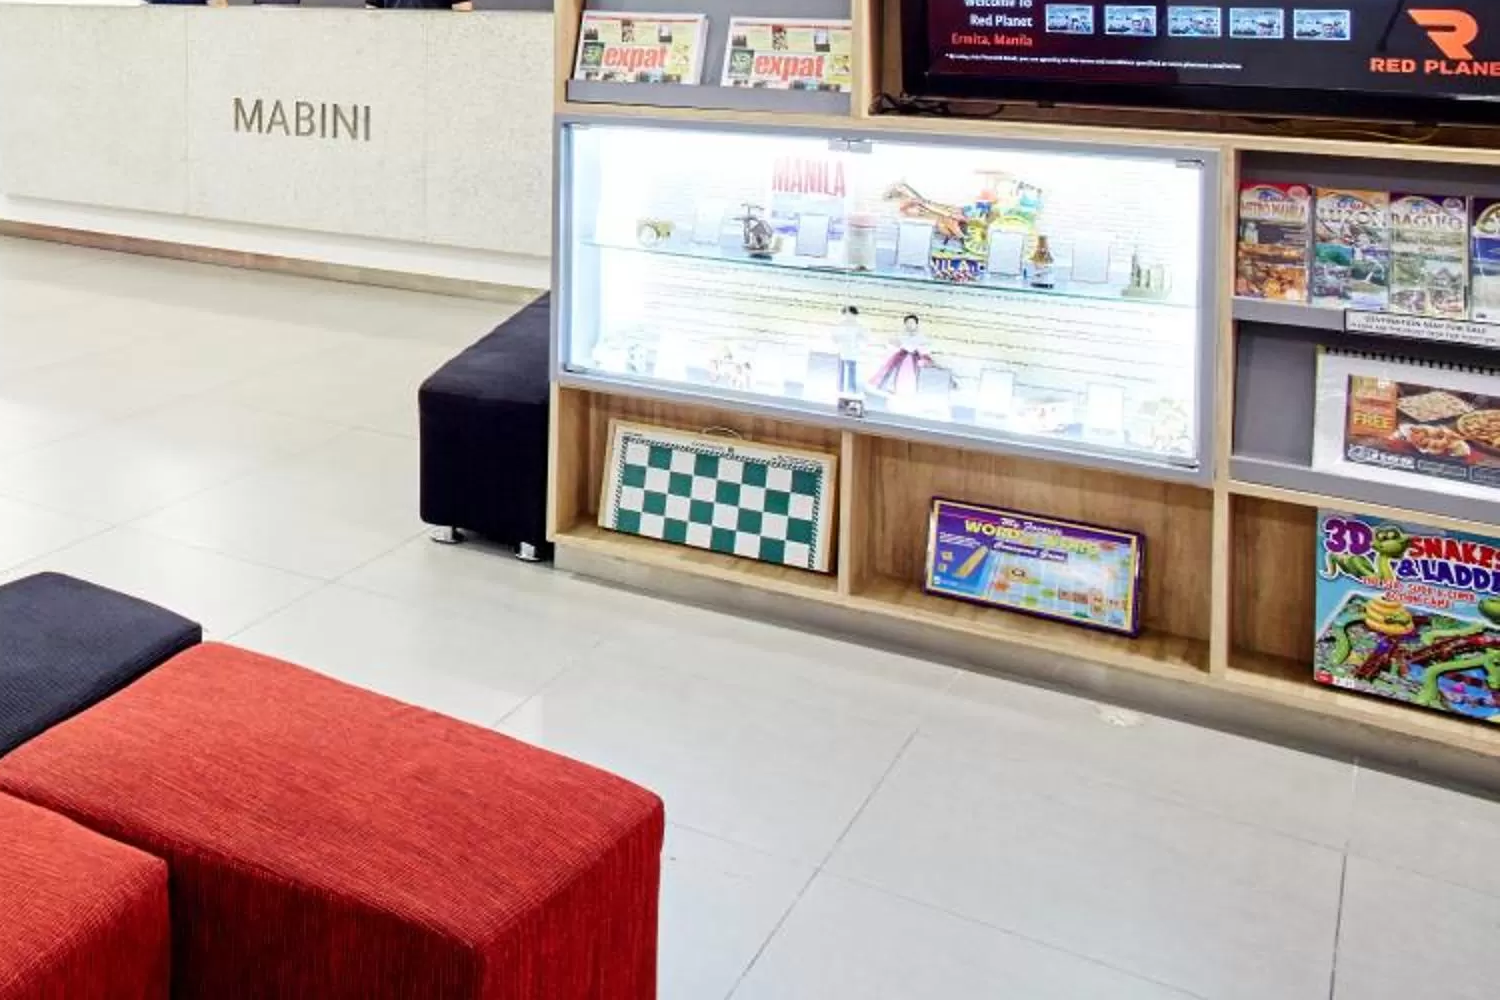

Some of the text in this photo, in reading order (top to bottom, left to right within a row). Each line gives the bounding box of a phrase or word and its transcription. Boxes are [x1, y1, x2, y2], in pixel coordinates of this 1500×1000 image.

[969, 13, 1033, 27] Red Planet
[951, 32, 1033, 46] Ermita, Manila
[603, 44, 669, 72] expat
[754, 54, 826, 81] expat
[1369, 57, 1416, 73] RED
[233, 97, 371, 142] MABINI
[771, 156, 846, 198] MANILA
[1325, 517, 1374, 555] 3D
